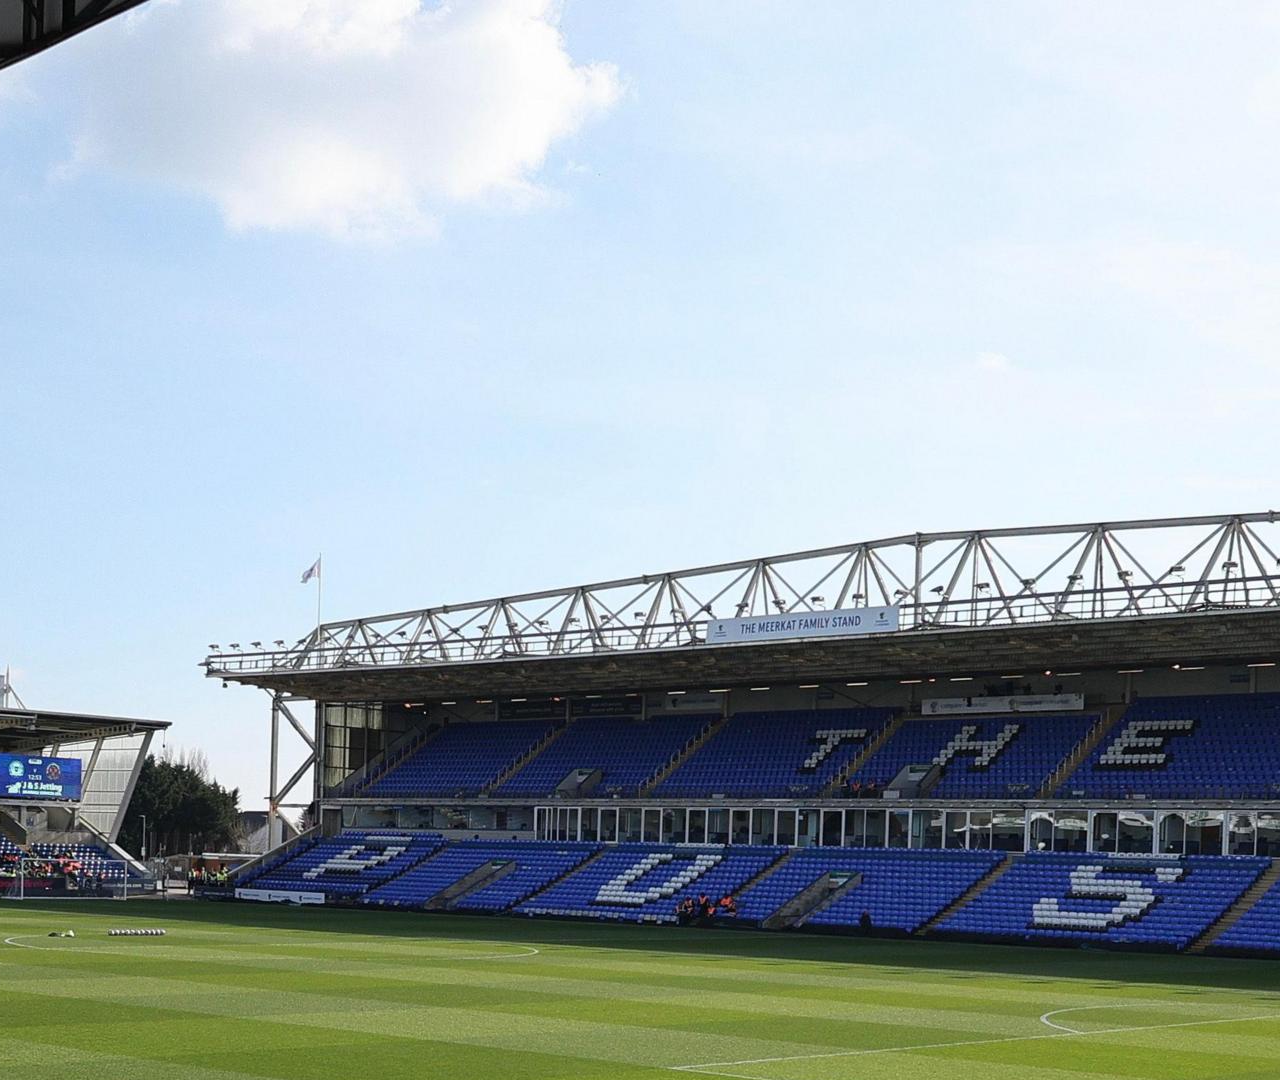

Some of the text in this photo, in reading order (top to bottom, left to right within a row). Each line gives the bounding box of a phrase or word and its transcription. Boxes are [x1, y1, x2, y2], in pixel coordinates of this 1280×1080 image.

[740, 624, 755, 634] THE
[758, 620, 796, 633] MEERKAT
[798, 617, 829, 630] FAMILY
[832, 615, 861, 628] STAND
